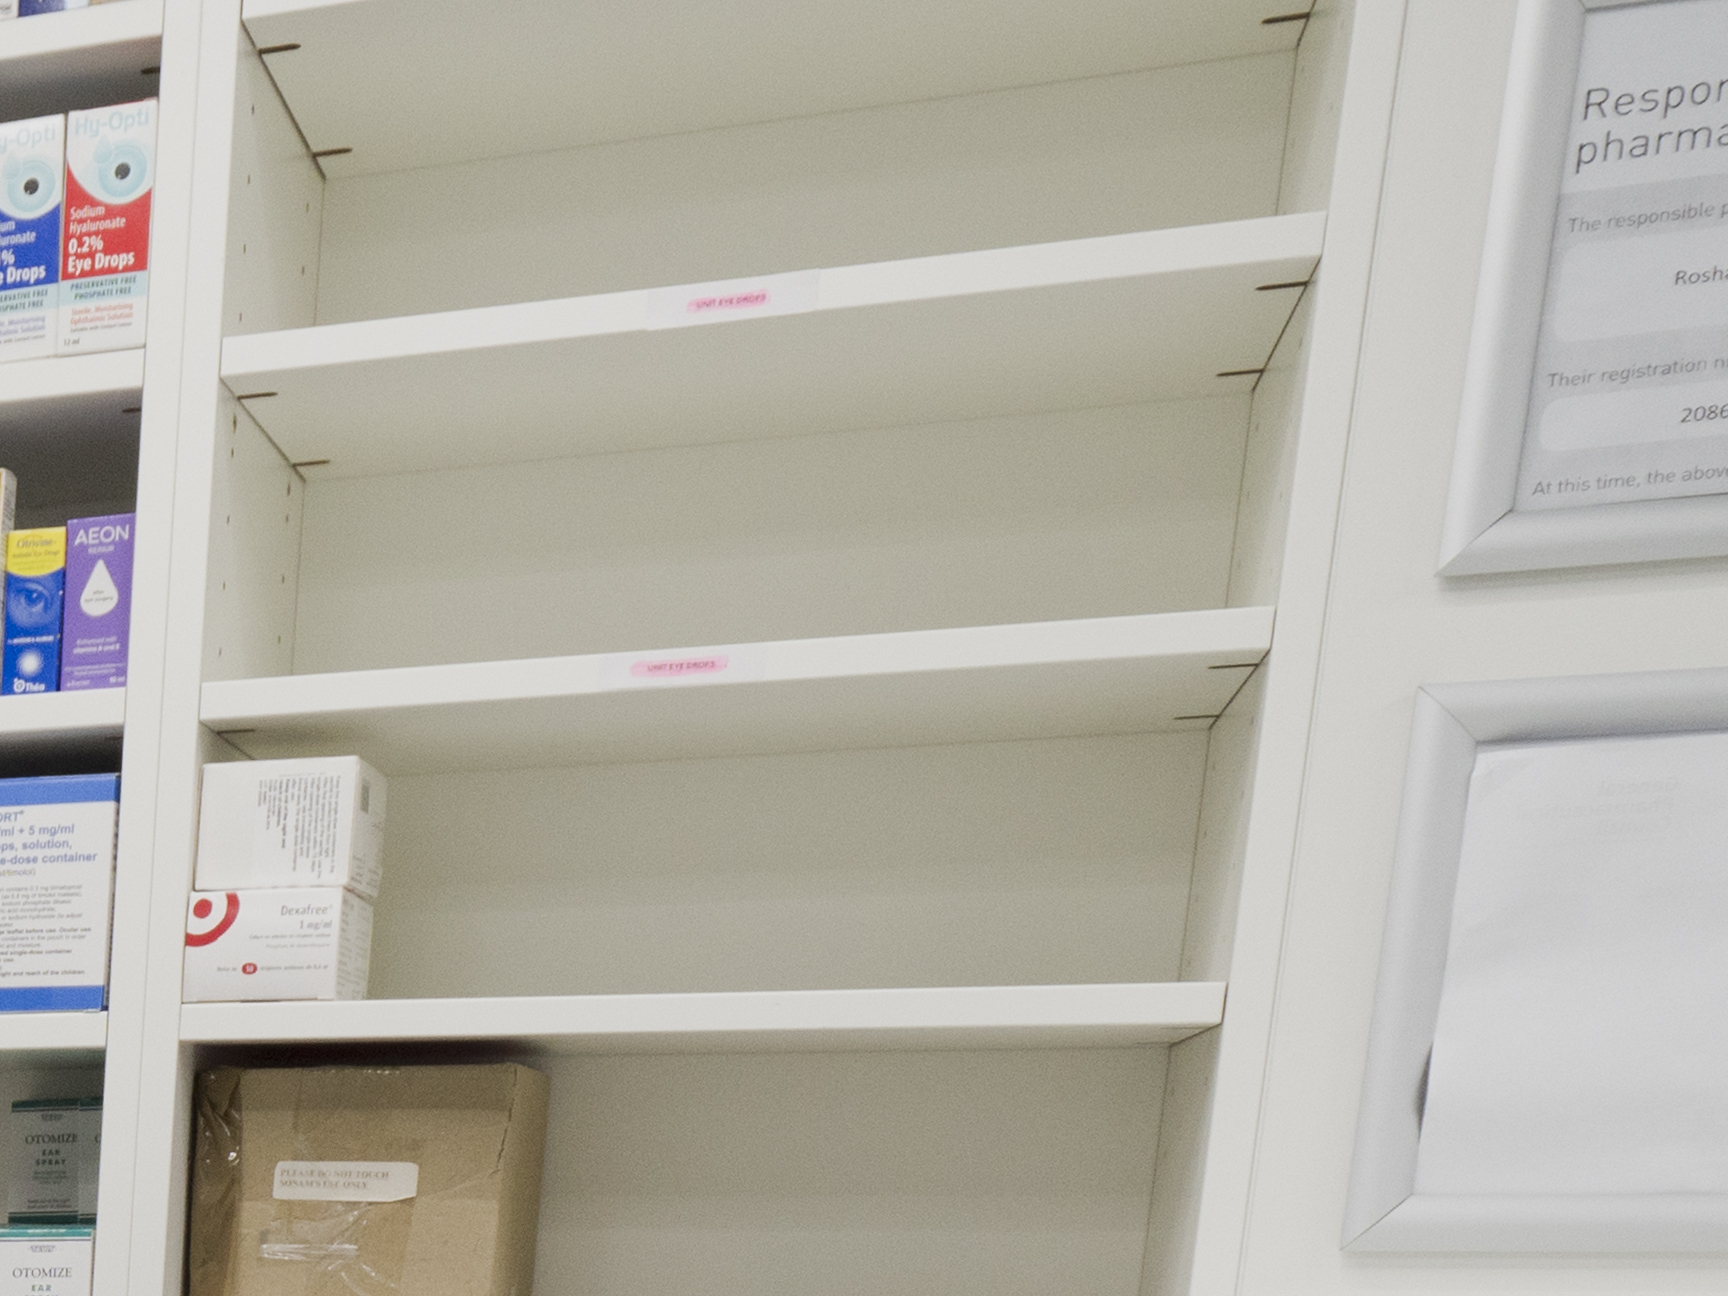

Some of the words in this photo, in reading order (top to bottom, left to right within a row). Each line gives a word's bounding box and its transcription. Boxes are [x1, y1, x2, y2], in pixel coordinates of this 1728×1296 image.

[75, 107, 150, 138] Hy-Opti
[69, 205, 106, 220] Sodium
[1568, 217, 1601, 233] The
[1607, 202, 1715, 230] responsible
[69, 215, 127, 235] Hyaluronate
[67, 235, 104, 254] 0.2%
[67, 255, 94, 276] Eye
[95, 251, 136, 271] Drops
[7, 266, 46, 286] Drops
[70, 277, 119, 291] PRESERVATIVE
[120, 274, 137, 286] FREE
[31, 288, 49, 300] FREE
[74, 288, 114, 300] PHOSPHATE
[115, 286, 132, 296] FREE
[1548, 372, 1595, 387] Their
[1601, 358, 1708, 384] registration
[1531, 481, 1552, 496] At
[1557, 477, 1591, 493] this
[1596, 475, 1642, 490] time,
[1647, 470, 1676, 485] the
[74, 524, 131, 546] AEON
[38, 822, 75, 839] mg/ml
[21, 838, 73, 853] solution,
[41, 850, 98, 865] container
[280, 904, 329, 917] Dexafree
[24, 1133, 78, 1146] OTOMIZE
[34, 1158, 67, 1167] SPRAY
[12, 1266, 73, 1279] OTOMIZE
[31, 1285, 52, 1293] EAR
